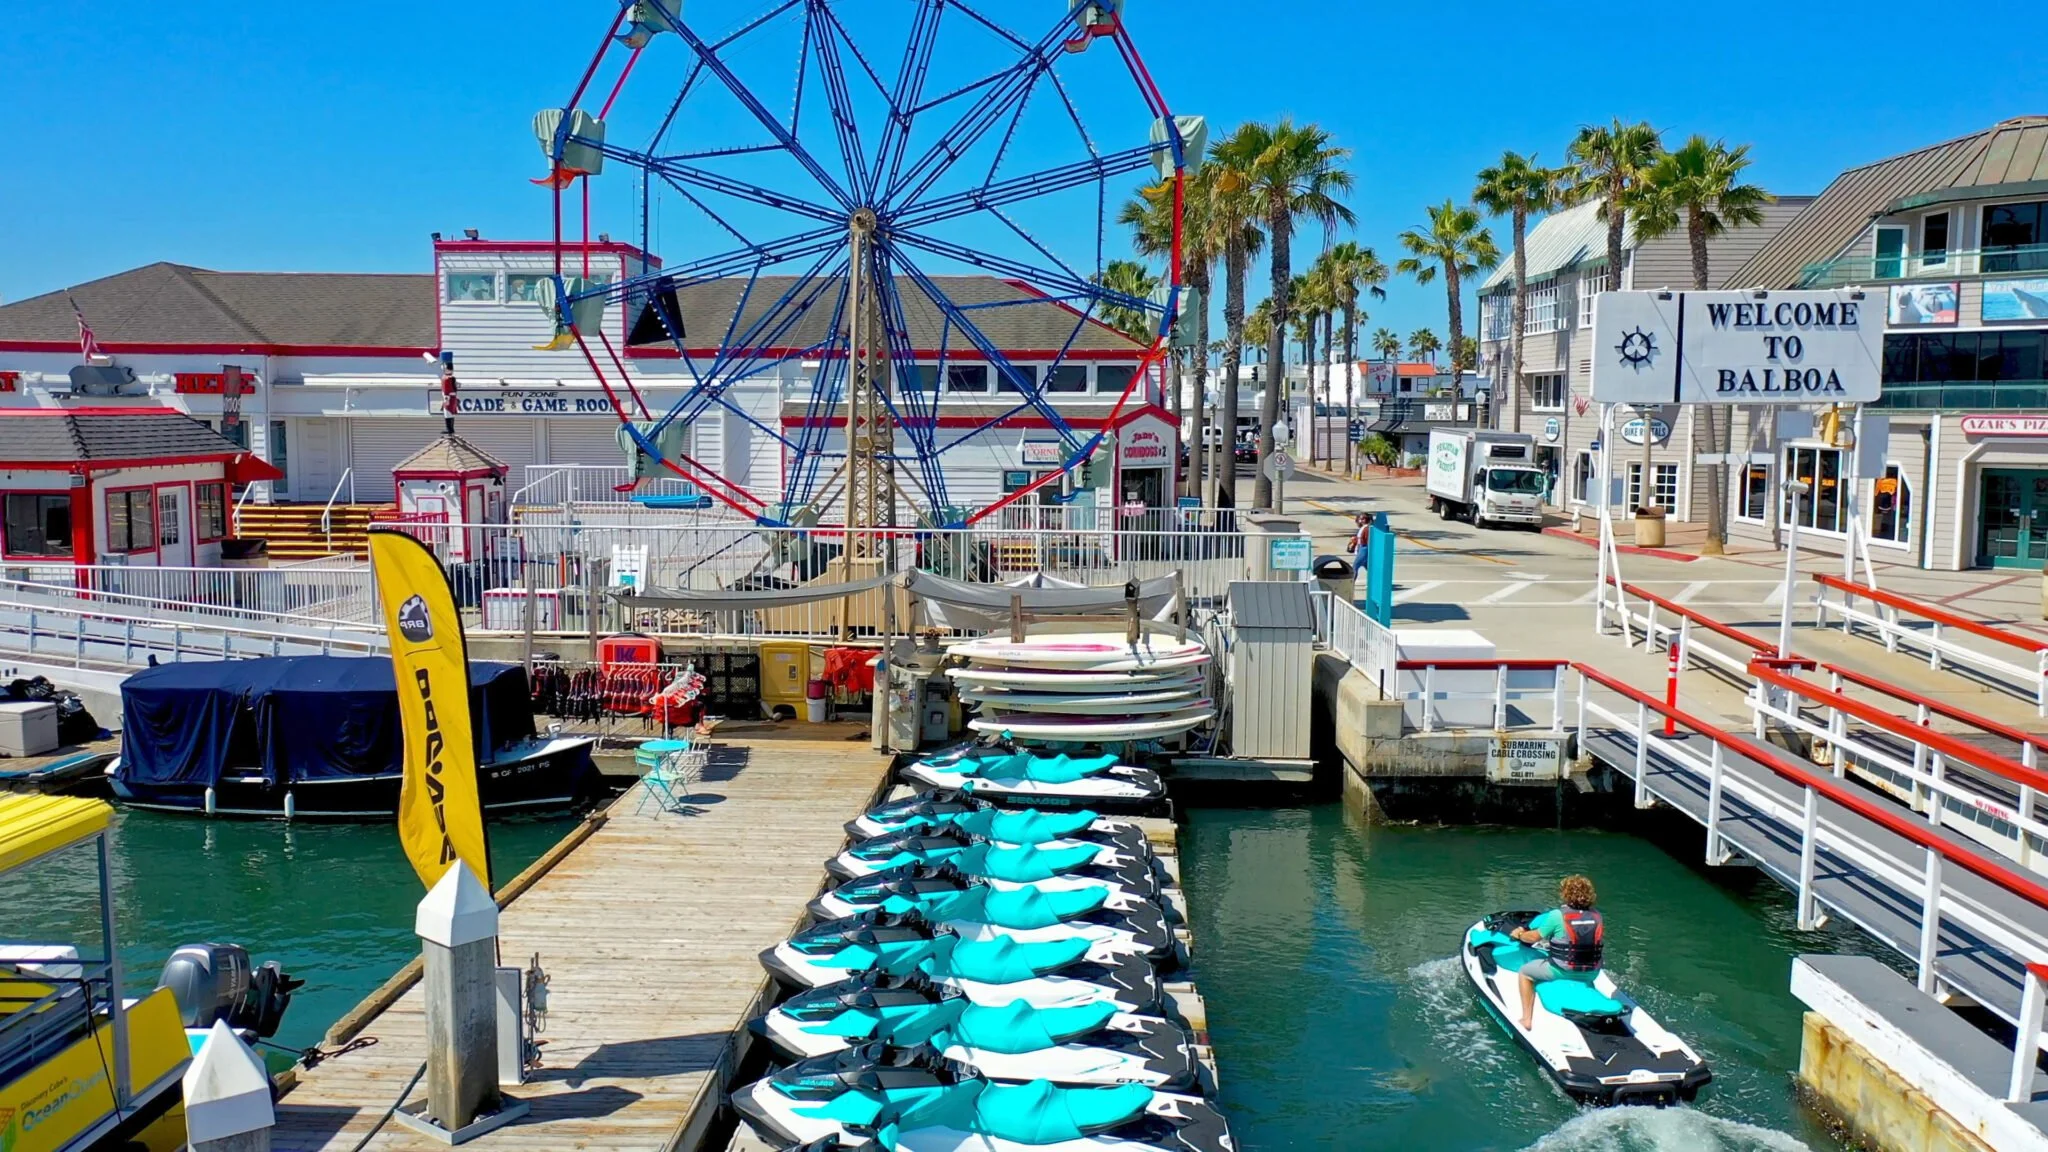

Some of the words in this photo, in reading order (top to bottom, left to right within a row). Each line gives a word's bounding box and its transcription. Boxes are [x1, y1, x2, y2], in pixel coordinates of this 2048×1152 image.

[1707, 302, 1859, 327] WELCOME
[1763, 335, 1803, 359] TO
[1716, 368, 1845, 393] BALBOA
[440, 398, 505, 413] CADE
[522, 398, 568, 413] GAME
[1966, 419, 2017, 430] AZAR'S
[1624, 427, 1638, 437] BIKE
[1640, 427, 1666, 437] RTALS
[1501, 740, 1547, 750] SUBMARINE
[1491, 748, 1515, 758] CABLE
[1516, 749, 1556, 759] CROSSING
[517, 764, 535, 774] 2021
[1974, 799, 1983, 808] NO
[1984, 803, 2010, 819] FISHING
